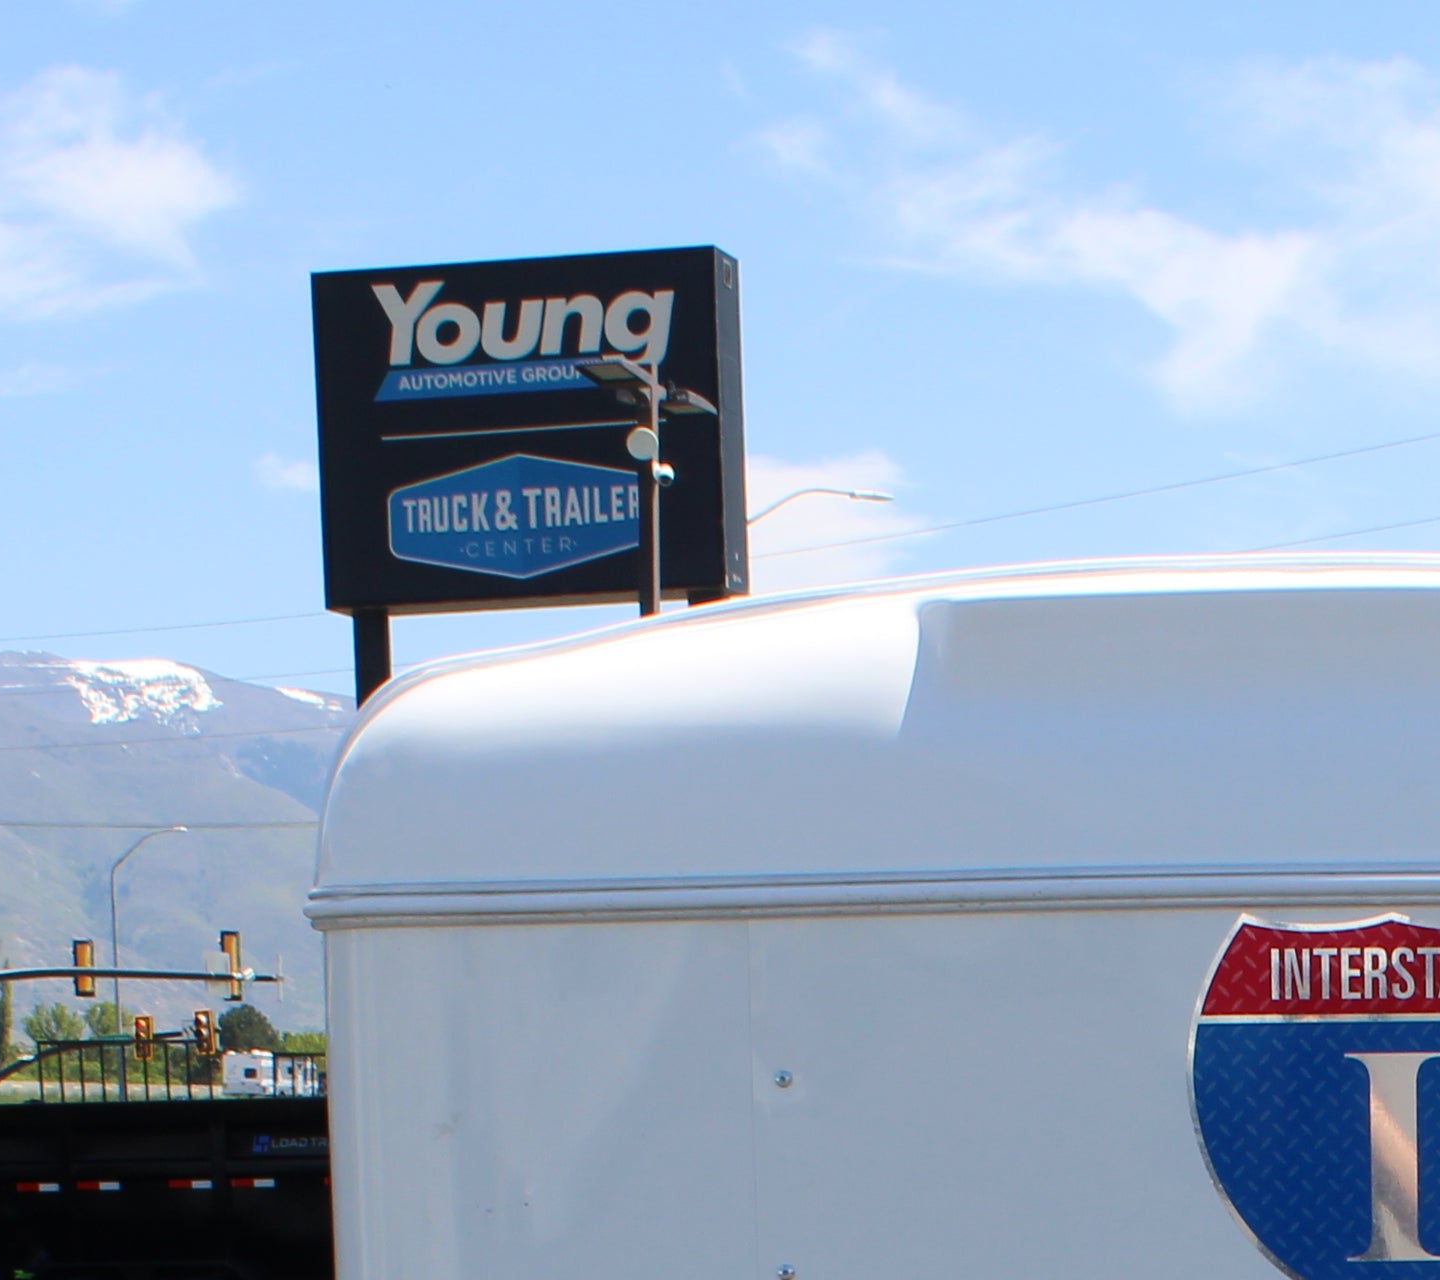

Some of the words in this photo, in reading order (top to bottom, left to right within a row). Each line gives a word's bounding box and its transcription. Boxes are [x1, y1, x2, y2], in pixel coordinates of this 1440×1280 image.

[371, 280, 675, 365] Young
[398, 368, 517, 391] AUTOMOTIVE
[402, 492, 490, 533] TRUCK
[494, 488, 519, 531] &
[522, 484, 639, 529] TRAILER
[464, 536, 572, 558] CENTER
